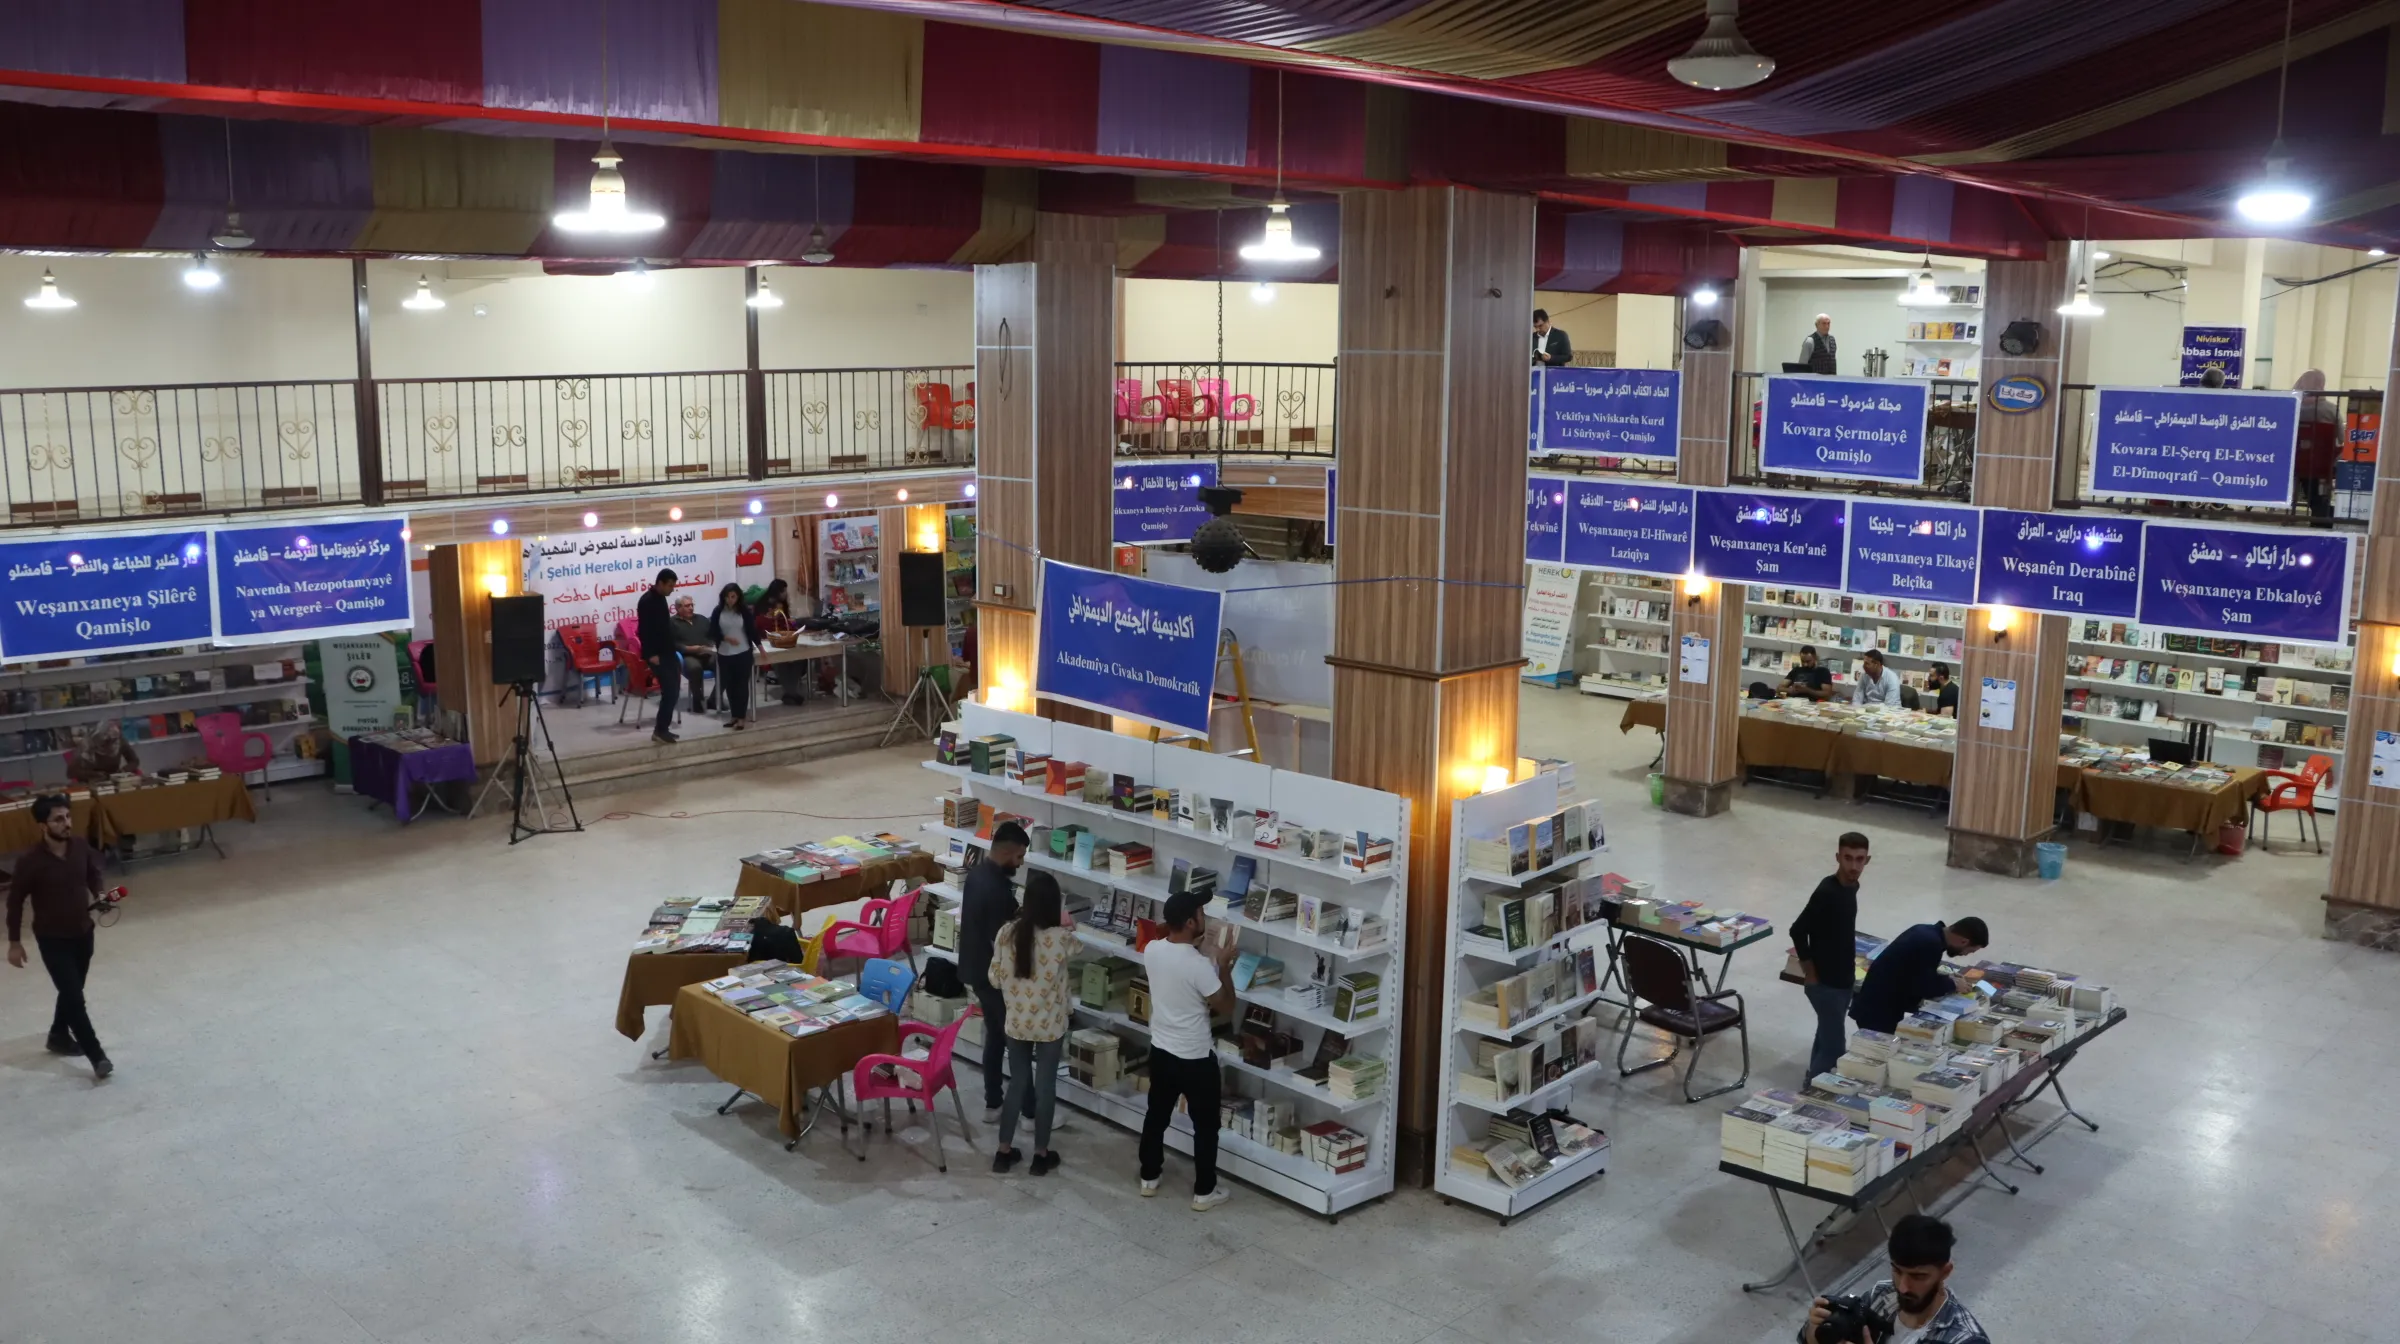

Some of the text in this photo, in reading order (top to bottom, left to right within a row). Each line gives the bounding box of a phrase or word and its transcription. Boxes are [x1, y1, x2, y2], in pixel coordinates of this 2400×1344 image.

[1552, 382, 1576, 395] قامشلو
[1584, 383, 1603, 396] سوريا
[1604, 382, 1614, 399] في
[1615, 384, 1632, 398] الكرد
[1653, 386, 1670, 398] اتحاد
[1790, 392, 1826, 408] قامشلو
[1840, 394, 1875, 412] شرمولا
[1878, 398, 1902, 414] مجلة
[1641, 415, 1665, 426] Kurd
[2114, 410, 2143, 425] قامشلو
[2154, 412, 2198, 429] الديمقراطي
[2199, 414, 2228, 430] الأوسط
[2230, 416, 2256, 431] الشرق
[2257, 416, 2278, 432] مجلة
[1562, 428, 1572, 437] Li
[1620, 430, 1656, 444] Qamişlo
[1782, 421, 1908, 446] Kovara Şermolayê
[1816, 446, 1872, 465] Qamişlo
[2110, 442, 2276, 464] Kovara El-Şerq El-Ewset
[1166, 476, 1178, 491] رونا
[2212, 471, 2269, 490] Qamişlo
[1536, 488, 1548, 510] دار
[1658, 500, 1677, 516] الحوار
[1678, 502, 1688, 516] دار
[1766, 506, 1789, 525] كنعان
[1789, 508, 1802, 527] دار
[1141, 522, 1168, 532] Qamişlo
[1578, 522, 1688, 544] Weşanxaneya El-Hîwarê
[1868, 516, 1894, 536] بلجيكا
[1952, 522, 1967, 540] دار
[2018, 521, 2045, 540] العراق
[2055, 524, 2082, 544] درابين
[368, 539, 390, 556] مركز
[580, 538, 618, 557] لمعرض
[620, 533, 664, 549] السادسة
[666, 530, 696, 547] الدورة
[1709, 534, 1827, 556] Weşanxaneya Ken'anê
[233, 546, 269, 566] قامشلو
[284, 544, 318, 562] للترجمة
[540, 540, 577, 560] الشهيد
[1858, 547, 1975, 572] Weşanxaneya Elkayê
[2188, 541, 2223, 565] دمشق
[2244, 544, 2277, 570] أبكالو
[2278, 547, 2296, 570] دار
[8, 560, 53, 580] قامشلو
[112, 554, 152, 573] للطباعة
[154, 554, 180, 570] شلير
[547, 563, 581, 582] Şehîd
[585, 560, 633, 576] Herekol
[636, 560, 644, 569] a
[647, 552, 698, 568] Pirtûkan
[1756, 558, 1779, 574] Şam
[2002, 556, 2136, 582] Weşanên Derabînê
[236, 573, 393, 598] Navenda Mezopotamyayê
[1892, 573, 1933, 590] Belçîka
[15, 586, 198, 618] Weşanxaneya Şilêrê
[2052, 586, 2084, 607] Iraq
[2160, 578, 2322, 608] Weşanxaneya Ebkaloyê
[250, 609, 266, 622] ya
[268, 600, 323, 618] Wergerê
[336, 596, 385, 612] Qamişlo
[1068, 594, 1195, 642] أكاديمية المجتمع الديمقراطي
[2222, 607, 2252, 624] Şam
[76, 616, 151, 640] Qamişlo
[1056, 650, 1201, 697] Akademîya Civaka Demokratîk
